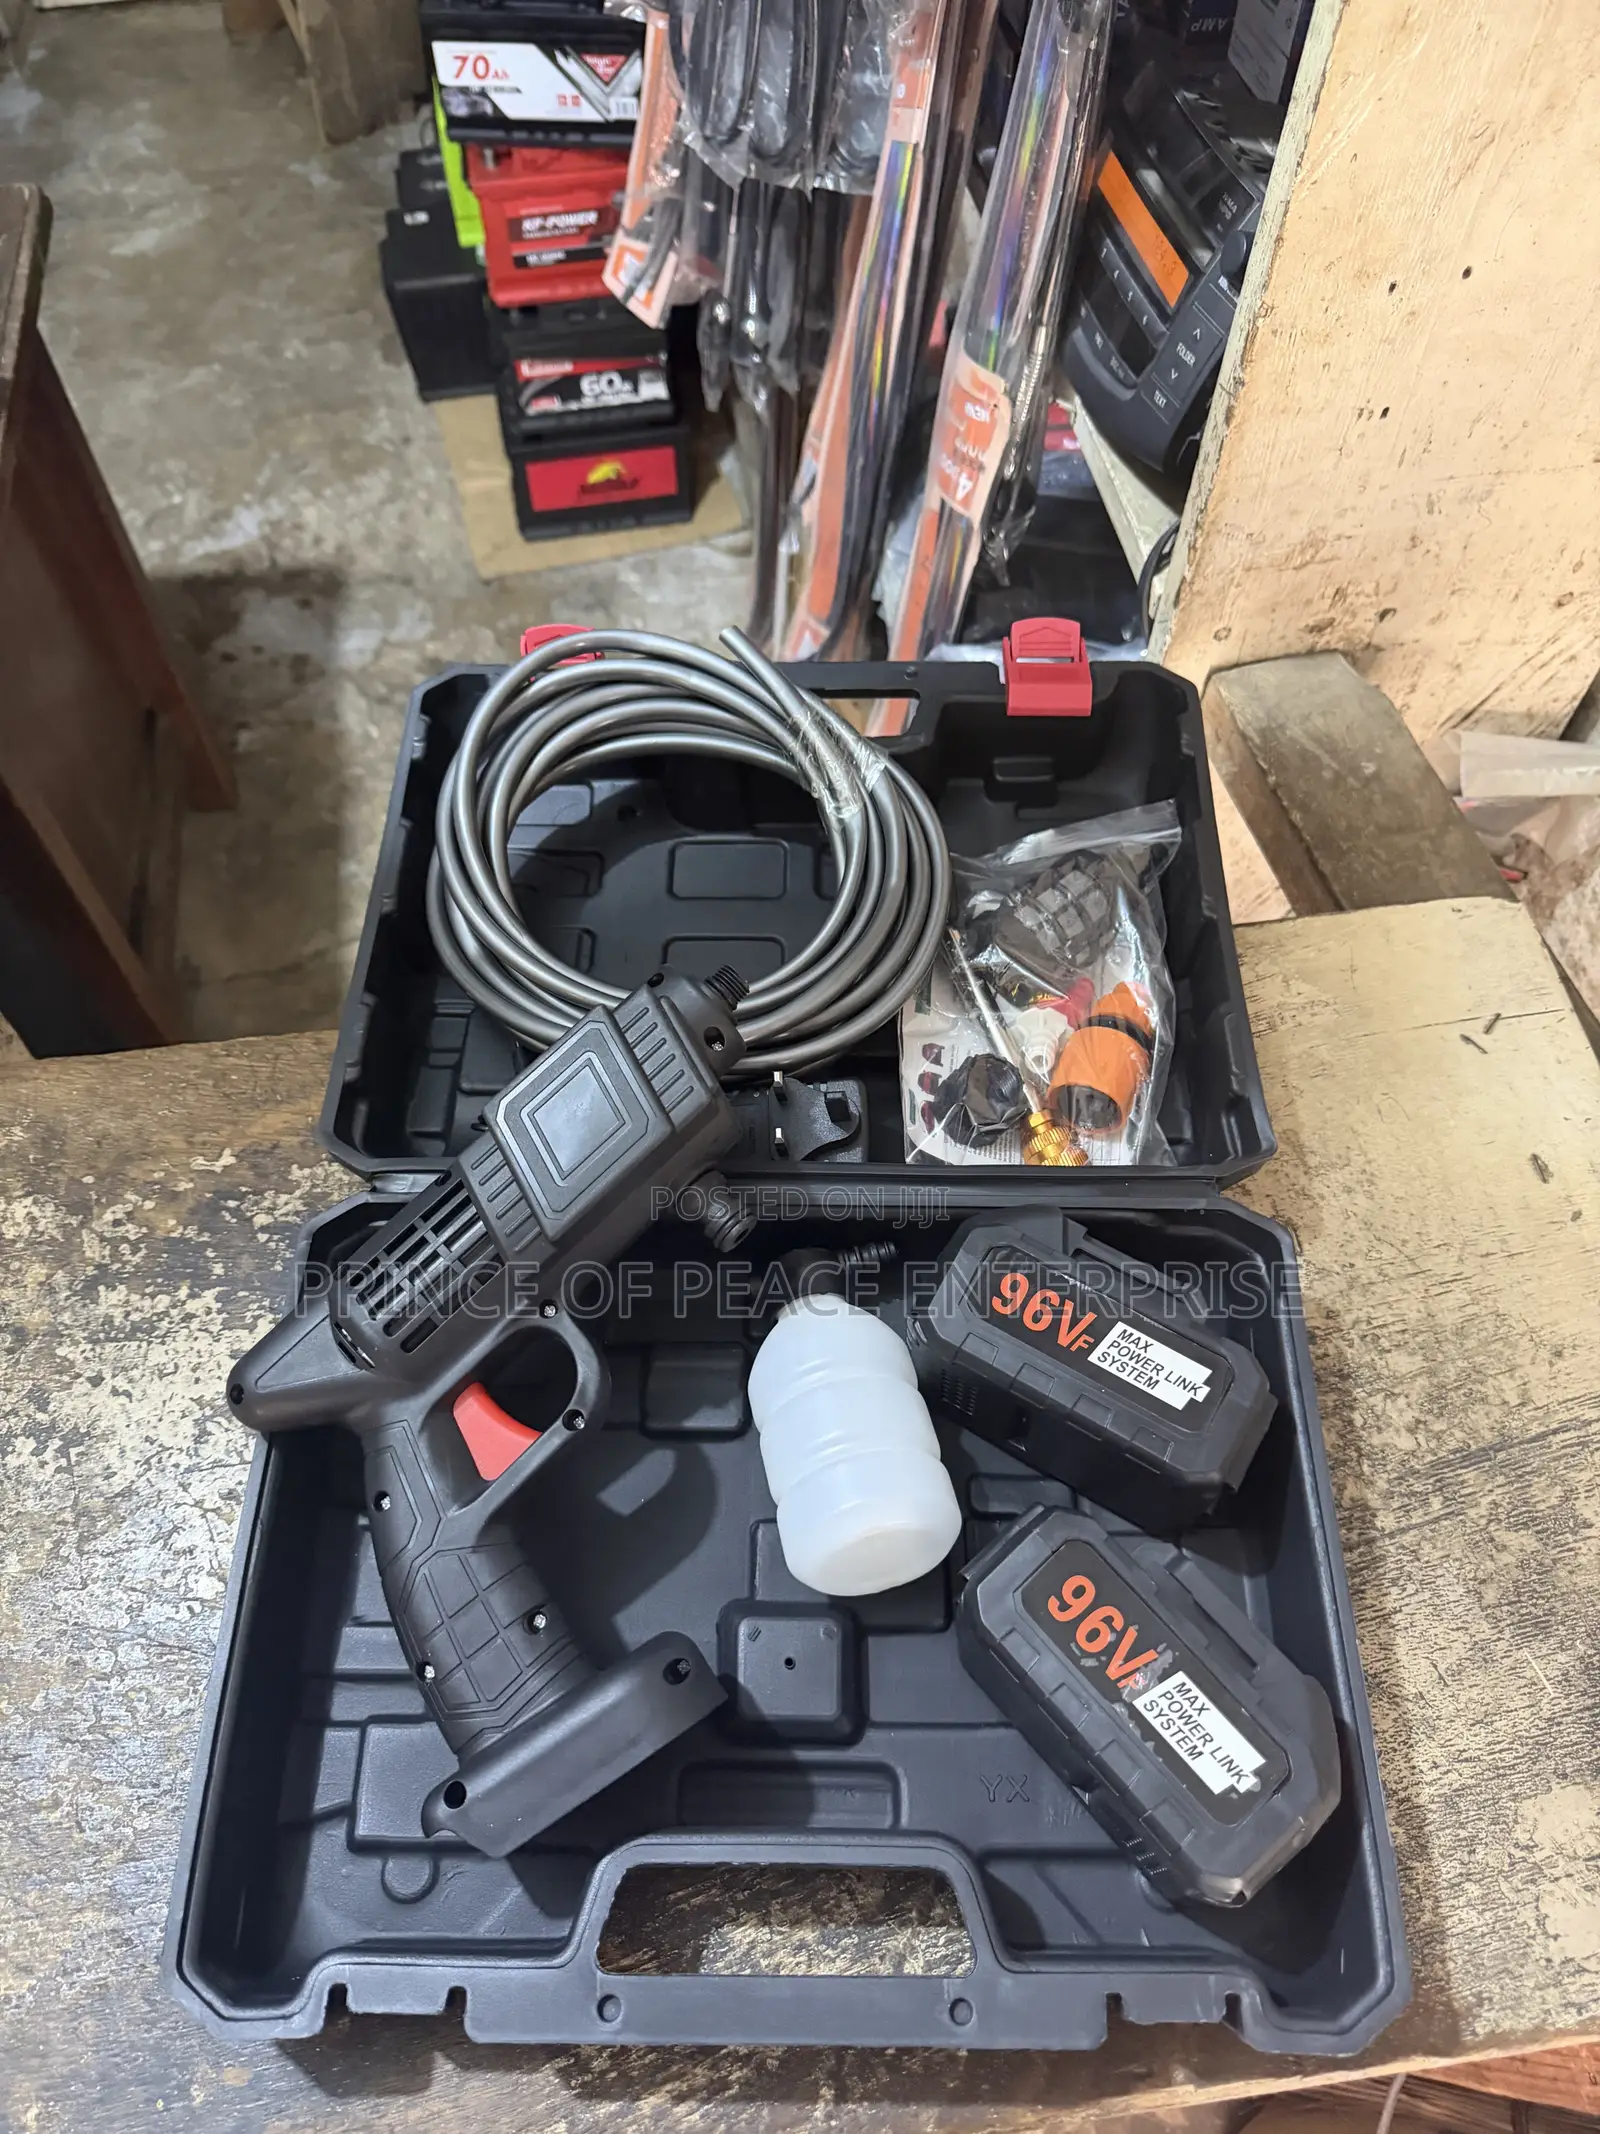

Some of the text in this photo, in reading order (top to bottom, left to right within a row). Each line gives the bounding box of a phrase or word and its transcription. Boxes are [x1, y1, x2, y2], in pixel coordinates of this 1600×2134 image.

[1191, 18, 1229, 32] AMP
[1176, 342, 1196, 368] FOLDER
[1153, 390, 1167, 409] TEXT
[1116, 1328, 1154, 1354] MAX
[1097, 1351, 1161, 1391] SYSTEM
[1107, 1339, 1204, 1398] POWER LINK
[1172, 1681, 1211, 1717] MAX
[1143, 1699, 1204, 1761] SYSTEM
[1158, 1690, 1251, 1787] POWER LINK
[980, 1773, 1031, 1803] YX
